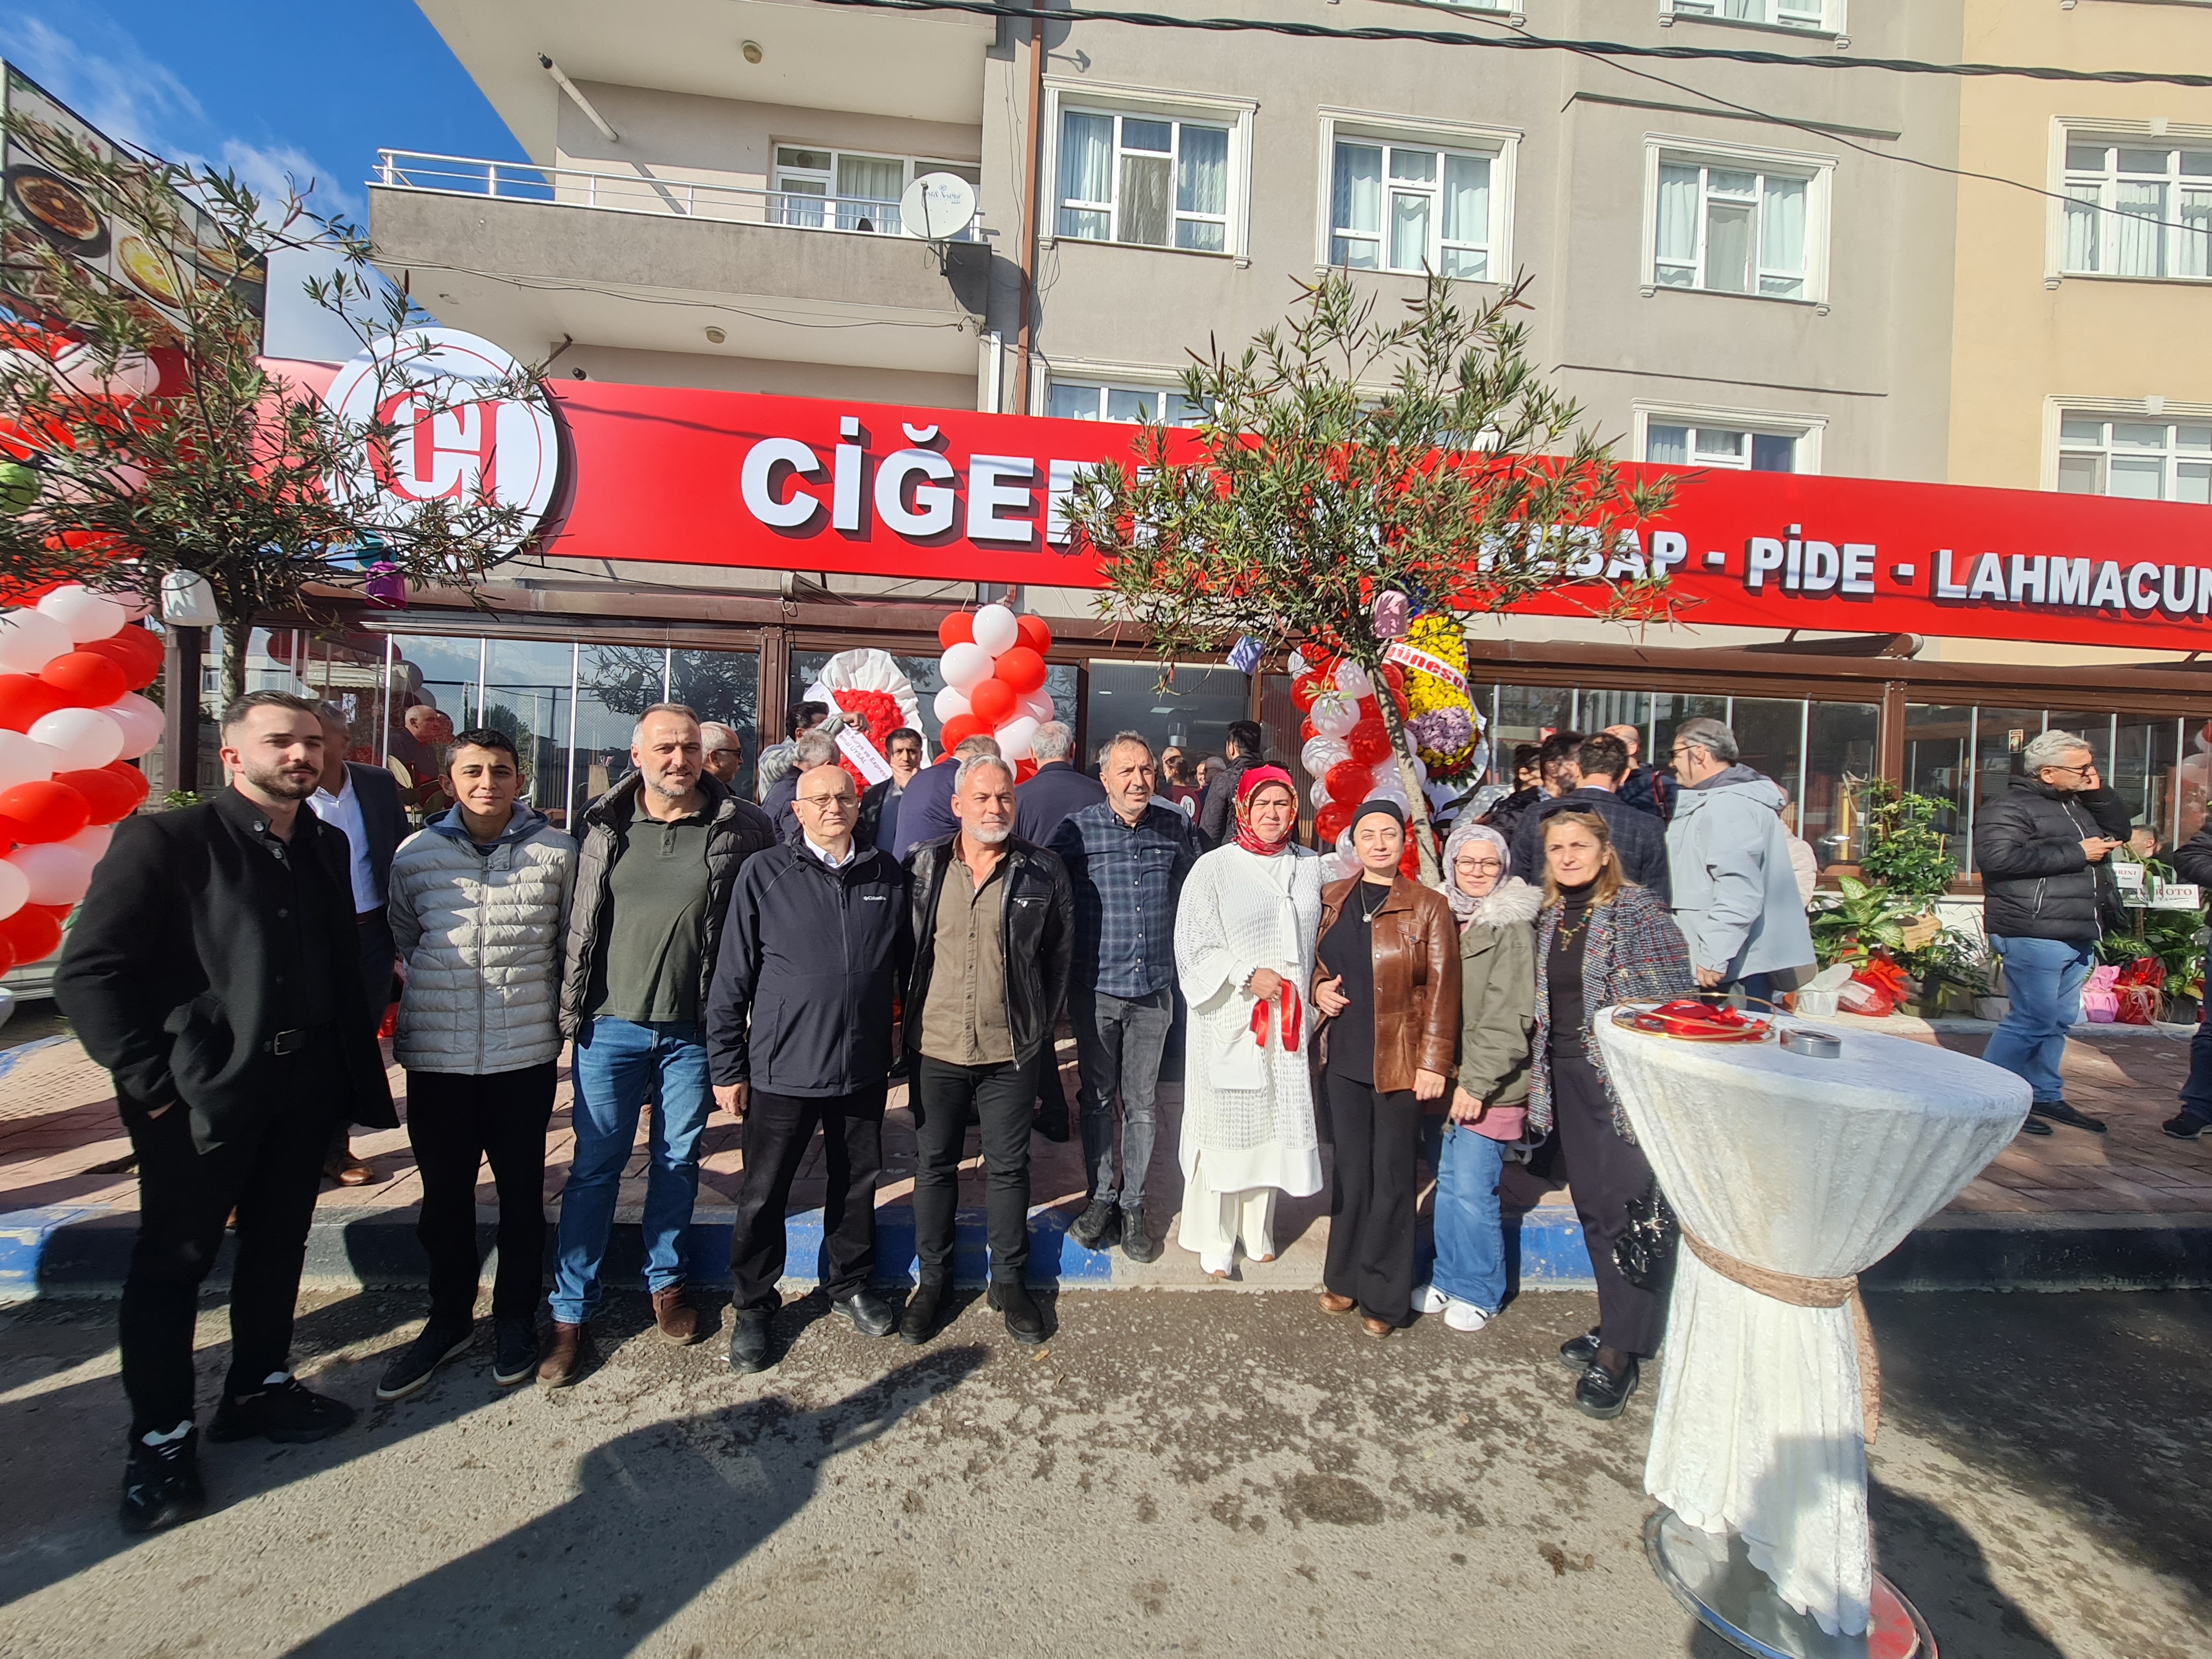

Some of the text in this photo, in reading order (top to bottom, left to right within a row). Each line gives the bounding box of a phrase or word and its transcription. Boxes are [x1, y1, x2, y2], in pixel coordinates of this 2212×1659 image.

[1750, 523, 1876, 593] PİDE
[838, 734, 867, 765] emal UYSAL
[851, 735, 864, 750] Kurye
[870, 757, 889, 779] Express
